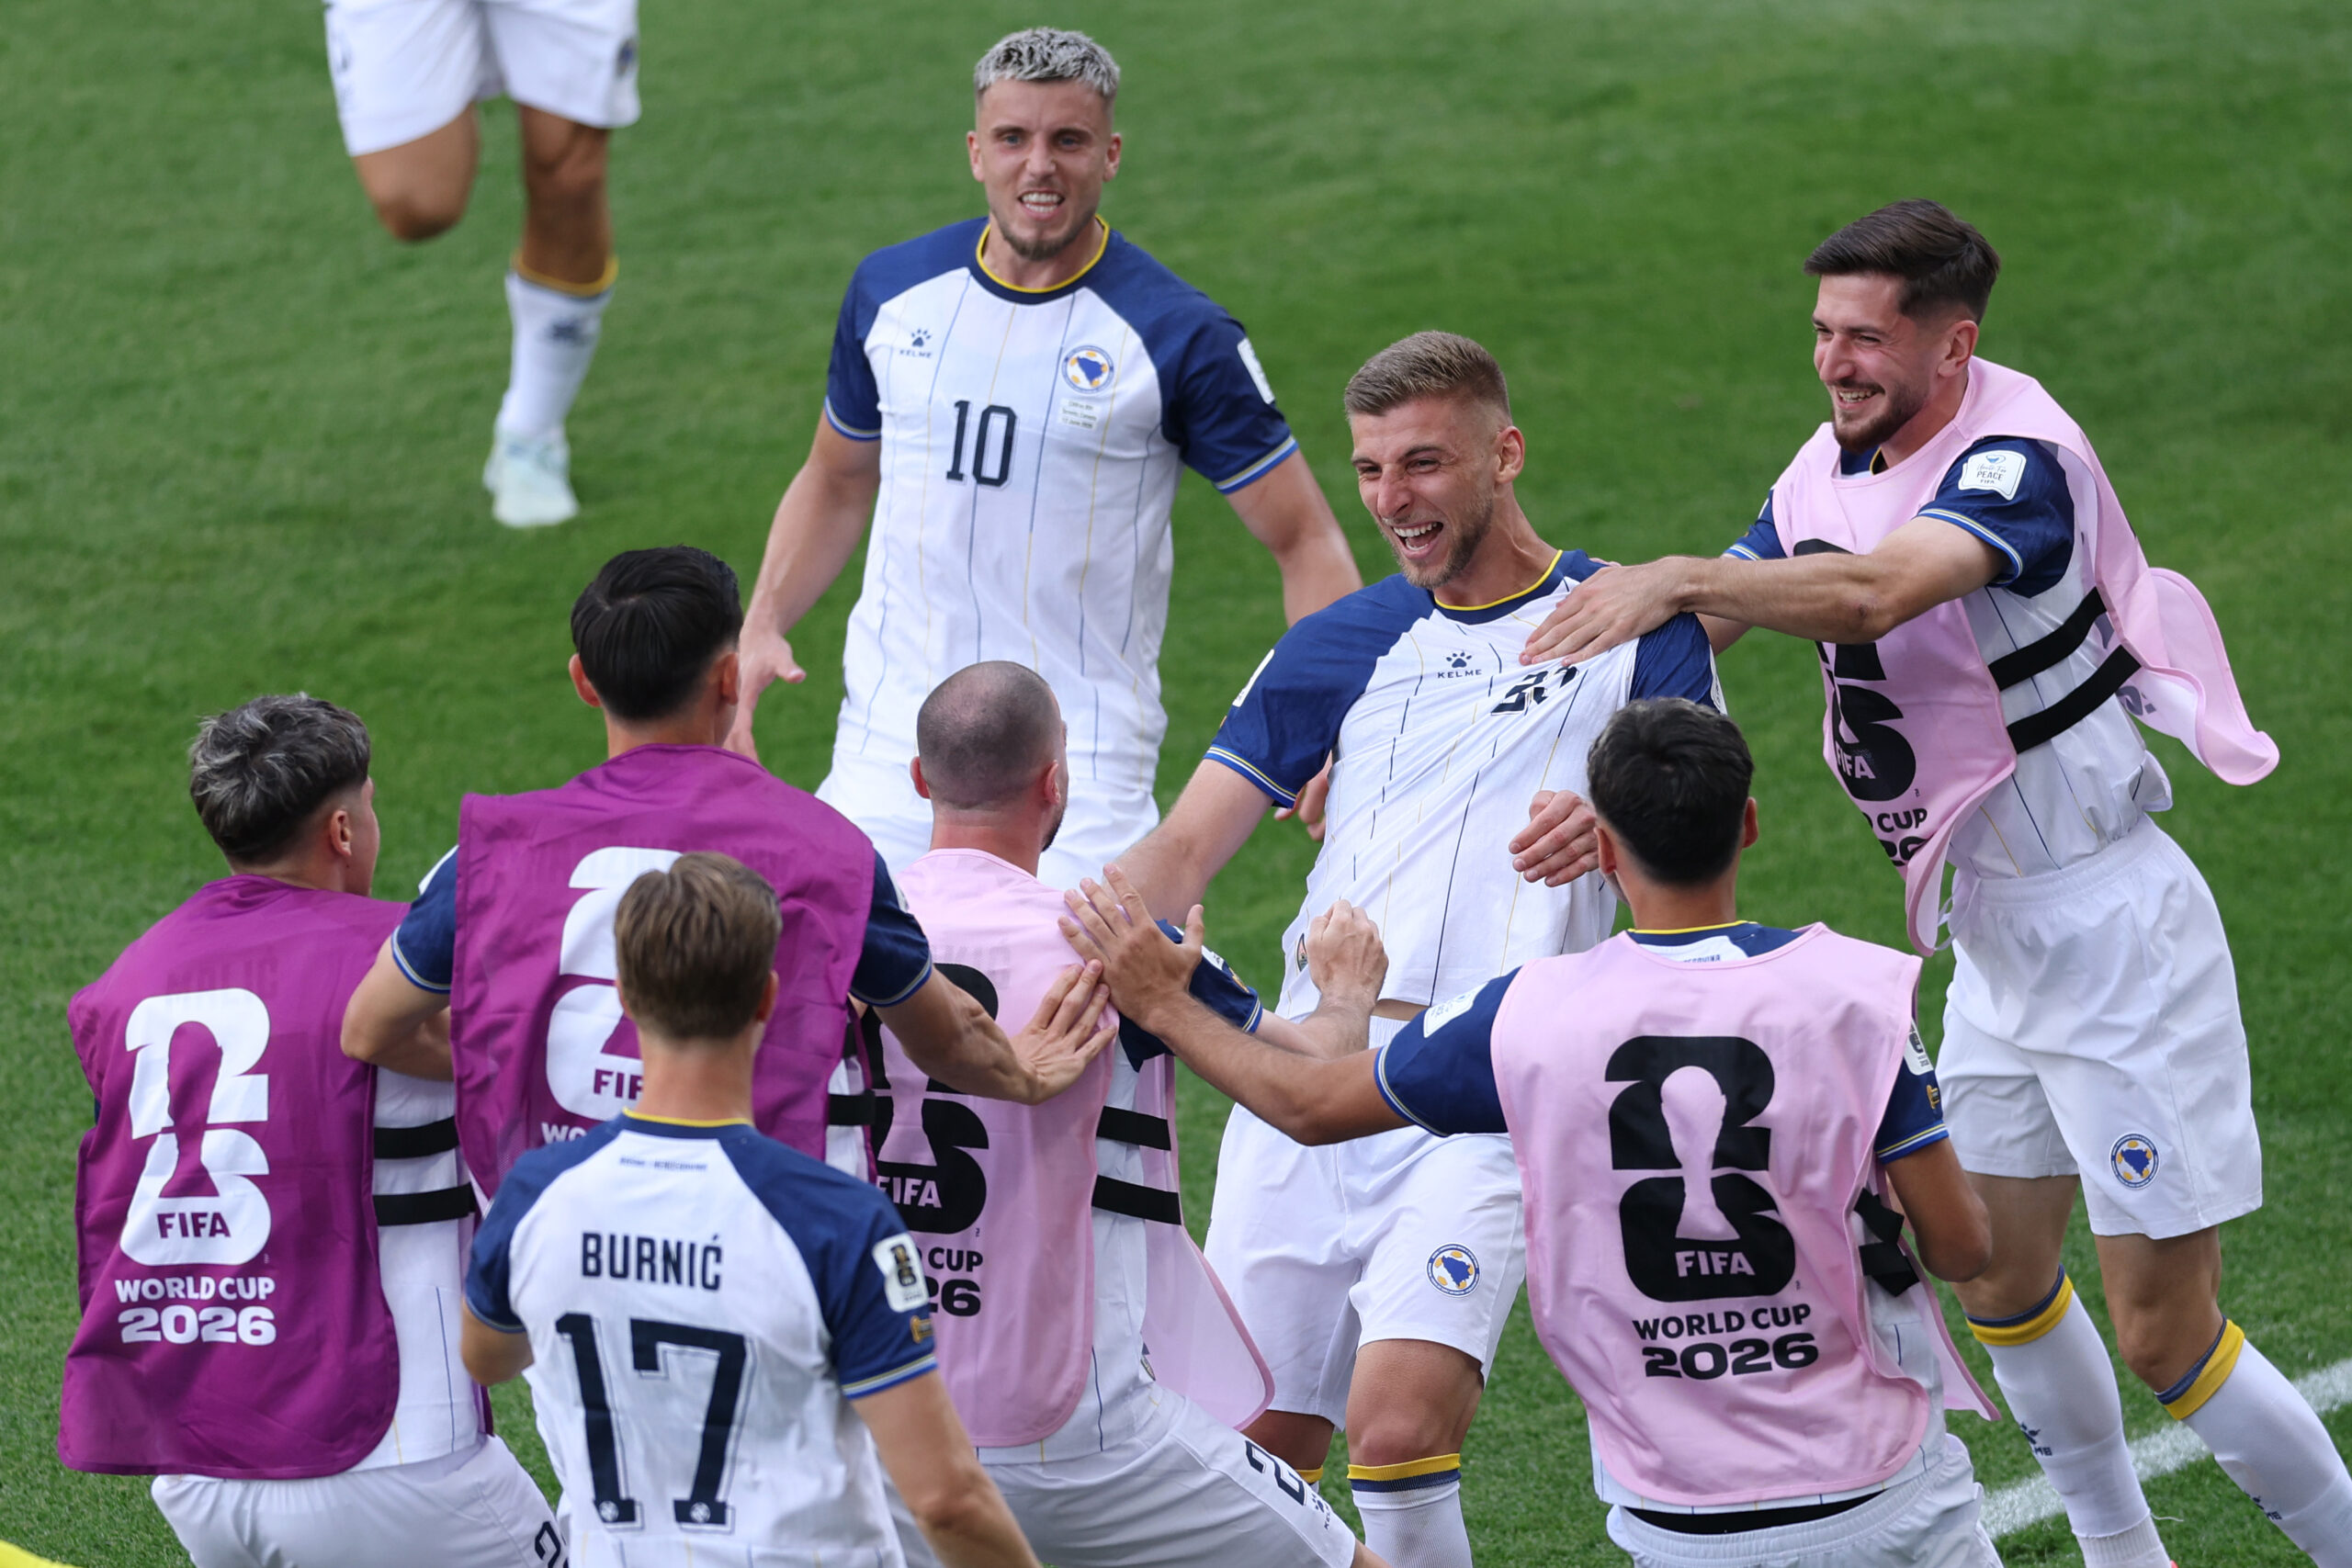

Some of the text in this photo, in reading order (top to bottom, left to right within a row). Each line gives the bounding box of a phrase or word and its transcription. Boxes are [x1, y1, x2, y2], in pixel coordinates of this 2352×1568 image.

[899, 349, 932, 358] KELME
[946, 400, 1017, 488] 10
[1976, 470, 2004, 481] PEACE
[1437, 669, 1482, 678] KELME
[1835, 740, 1876, 779] FIFA
[1877, 807, 1928, 833] CUP
[594, 1068, 643, 1100] FIF
[876, 1175, 942, 1209] FIFA
[157, 1212, 231, 1238] FIFA
[582, 1232, 723, 1292] BURNIĆ
[928, 1247, 983, 1272] CUP
[1675, 1250, 1756, 1278] FIFA
[115, 1276, 276, 1303] WORLD CUP
[118, 1304, 277, 1346] 2026
[1632, 1303, 1811, 1340] WORLD CUP
[1642, 1332, 1819, 1381] 2026
[555, 1313, 750, 1529] 17
